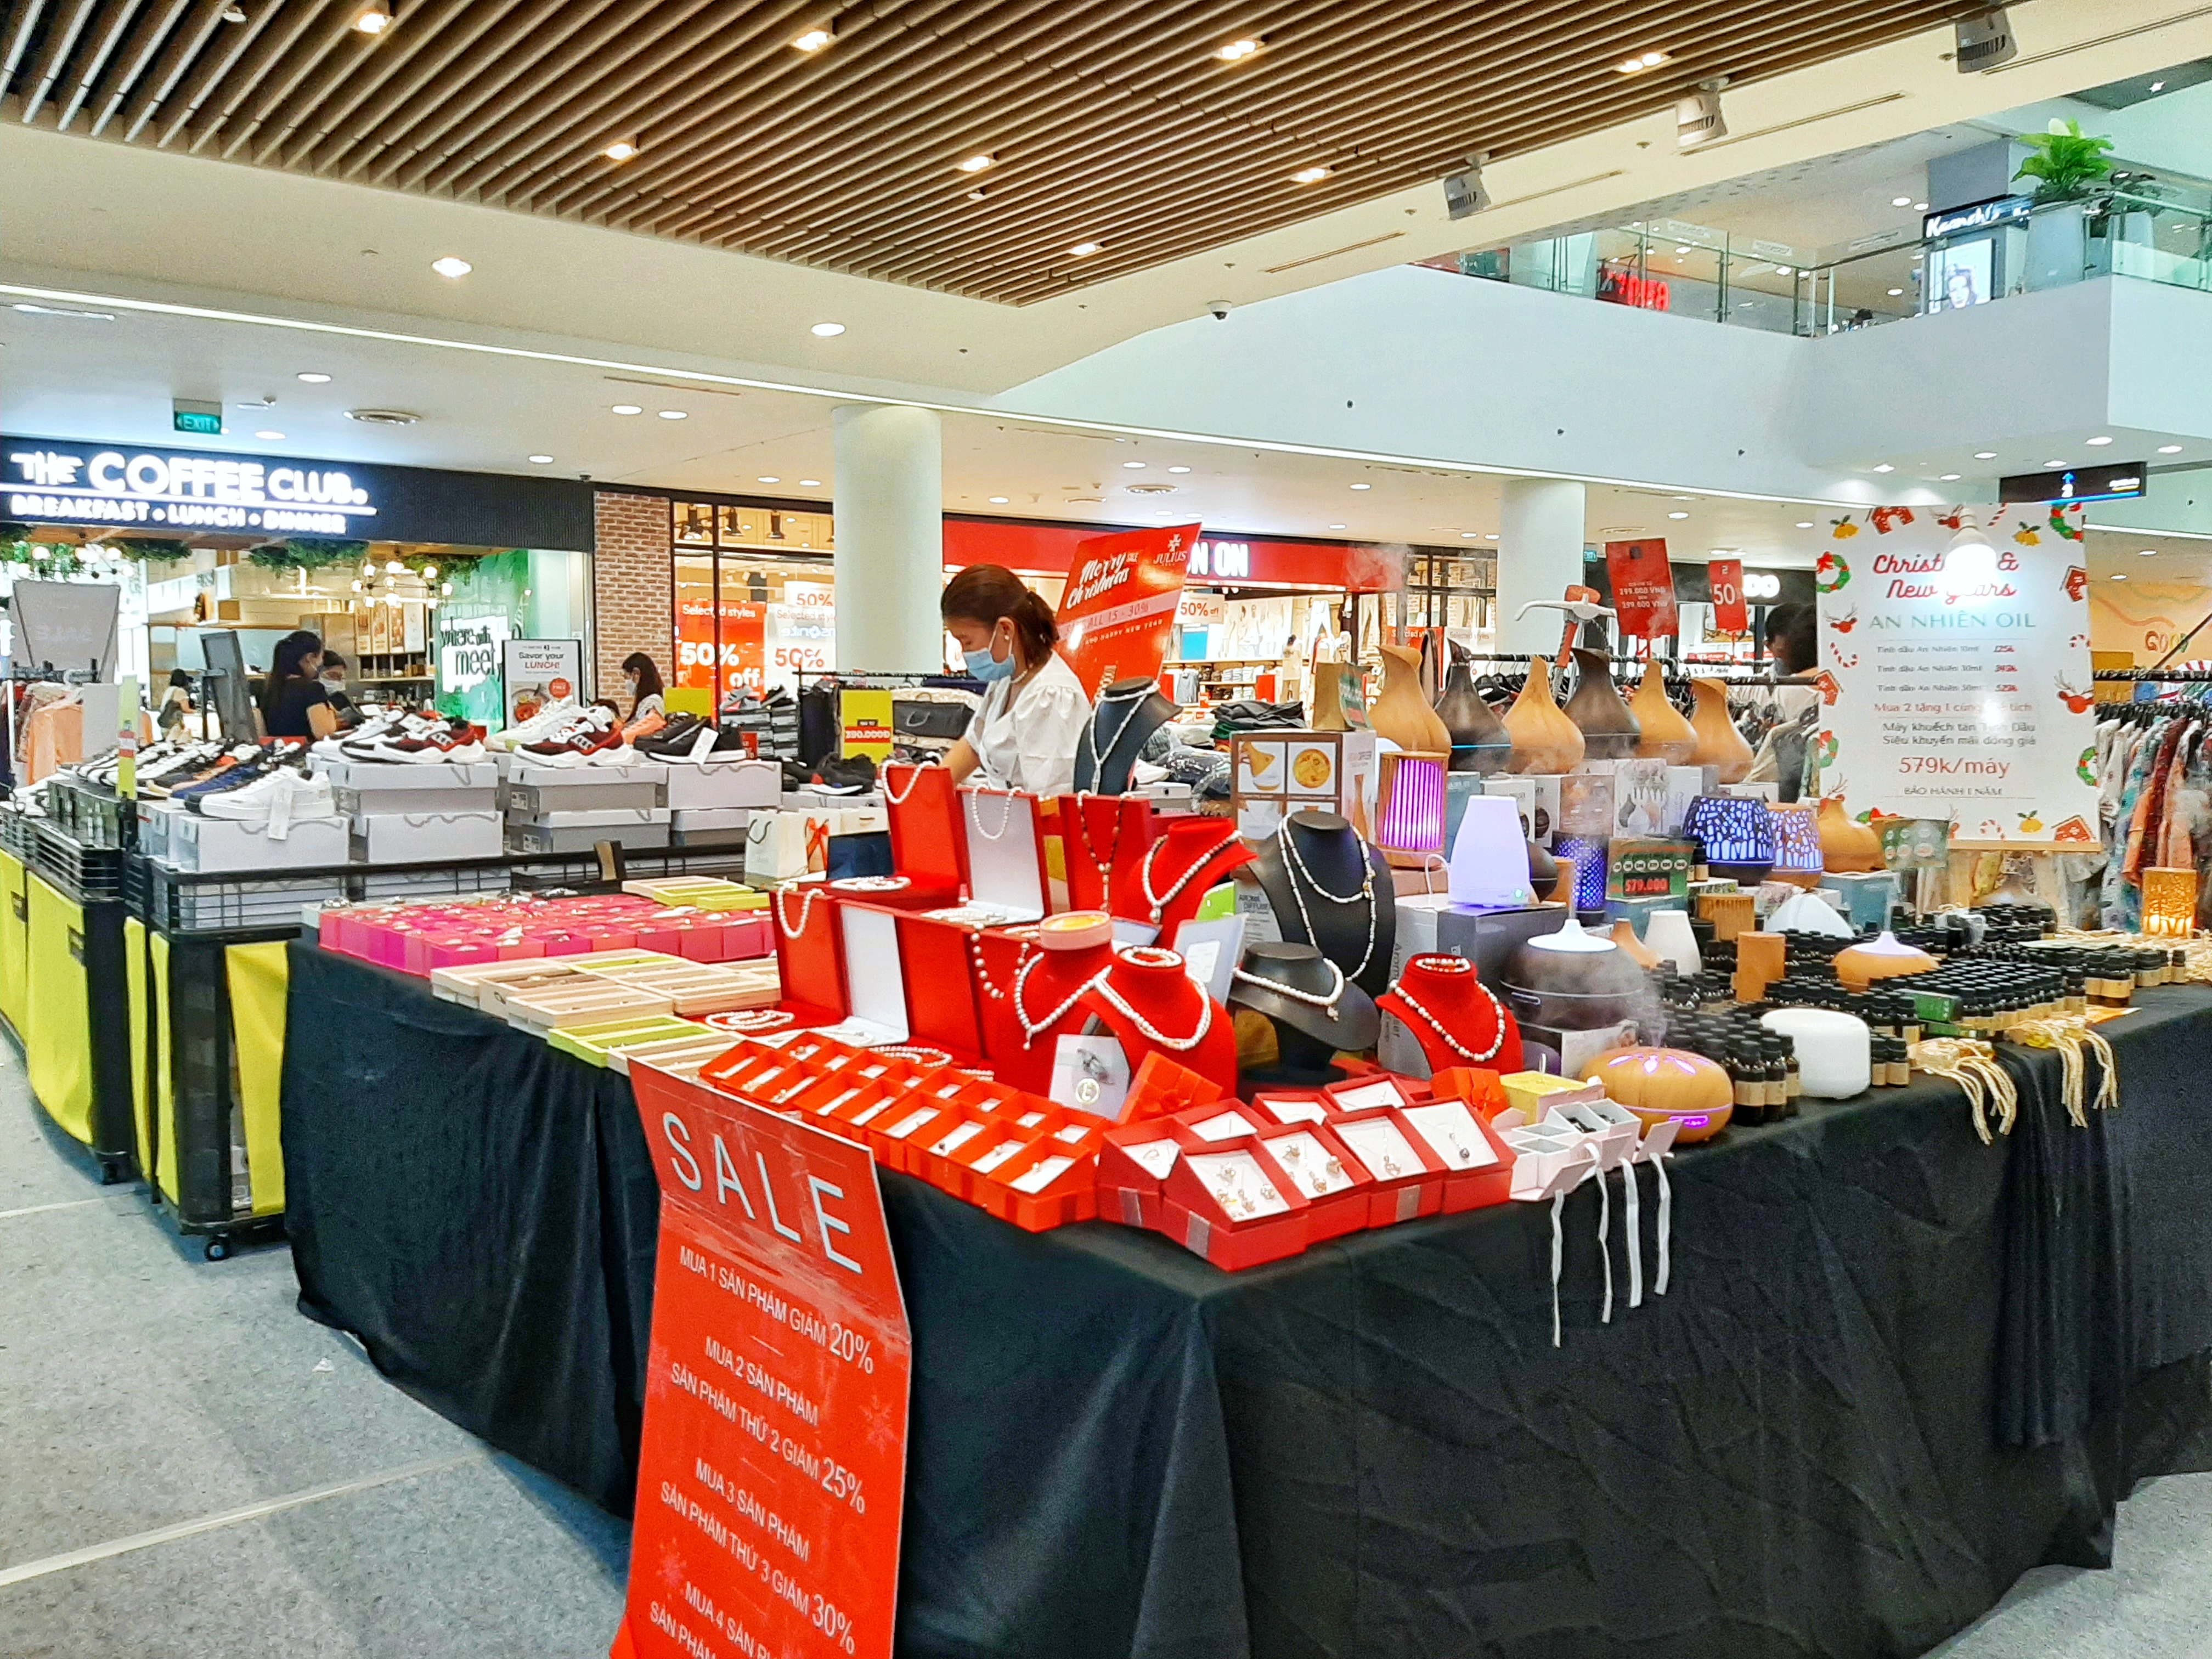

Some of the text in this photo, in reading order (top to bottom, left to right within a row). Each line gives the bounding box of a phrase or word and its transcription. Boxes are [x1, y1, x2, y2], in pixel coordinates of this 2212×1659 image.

[183, 416, 211, 431] EXIT
[10, 451, 84, 485] THE
[88, 452, 266, 501] COFFEE
[11, 494, 150, 521] BREAKFAST
[168, 504, 245, 527] LUNCH
[1080, 552, 1126, 585] Merry
[1153, 551, 1187, 564] JULIUS
[1214, 541, 1249, 578] ON
[1997, 552, 2019, 571] &
[1066, 568, 1130, 609] Christmas
[1886, 579, 1938, 599] New
[682, 604, 756, 619] Selectd styles
[1180, 602, 1209, 617] 50%
[1869, 610, 2036, 629] AN NHIÊN OIL
[680, 641, 740, 667] 50%
[729, 668, 760, 687] off
[1903, 703, 1911, 712] 2
[1899, 757, 2010, 779] 579k/máy
[662, 1111, 862, 1275] SALE
[680, 1246, 707, 1279] MUA
[709, 1262, 716, 1282] 1
[830, 1323, 874, 1375] 20%
[706, 1335, 734, 1372] MUA
[735, 1356, 744, 1379] 2
[696, 1457, 725, 1497] MUA
[726, 1481, 735, 1504] 3
[770, 1429, 780, 1453] 2
[822, 1457, 866, 1515] 25%
[685, 1581, 714, 1623] MUA
[716, 1610, 725, 1630] 4
[761, 1559, 770, 1583] 3
[812, 1593, 855, 1656] 30%
